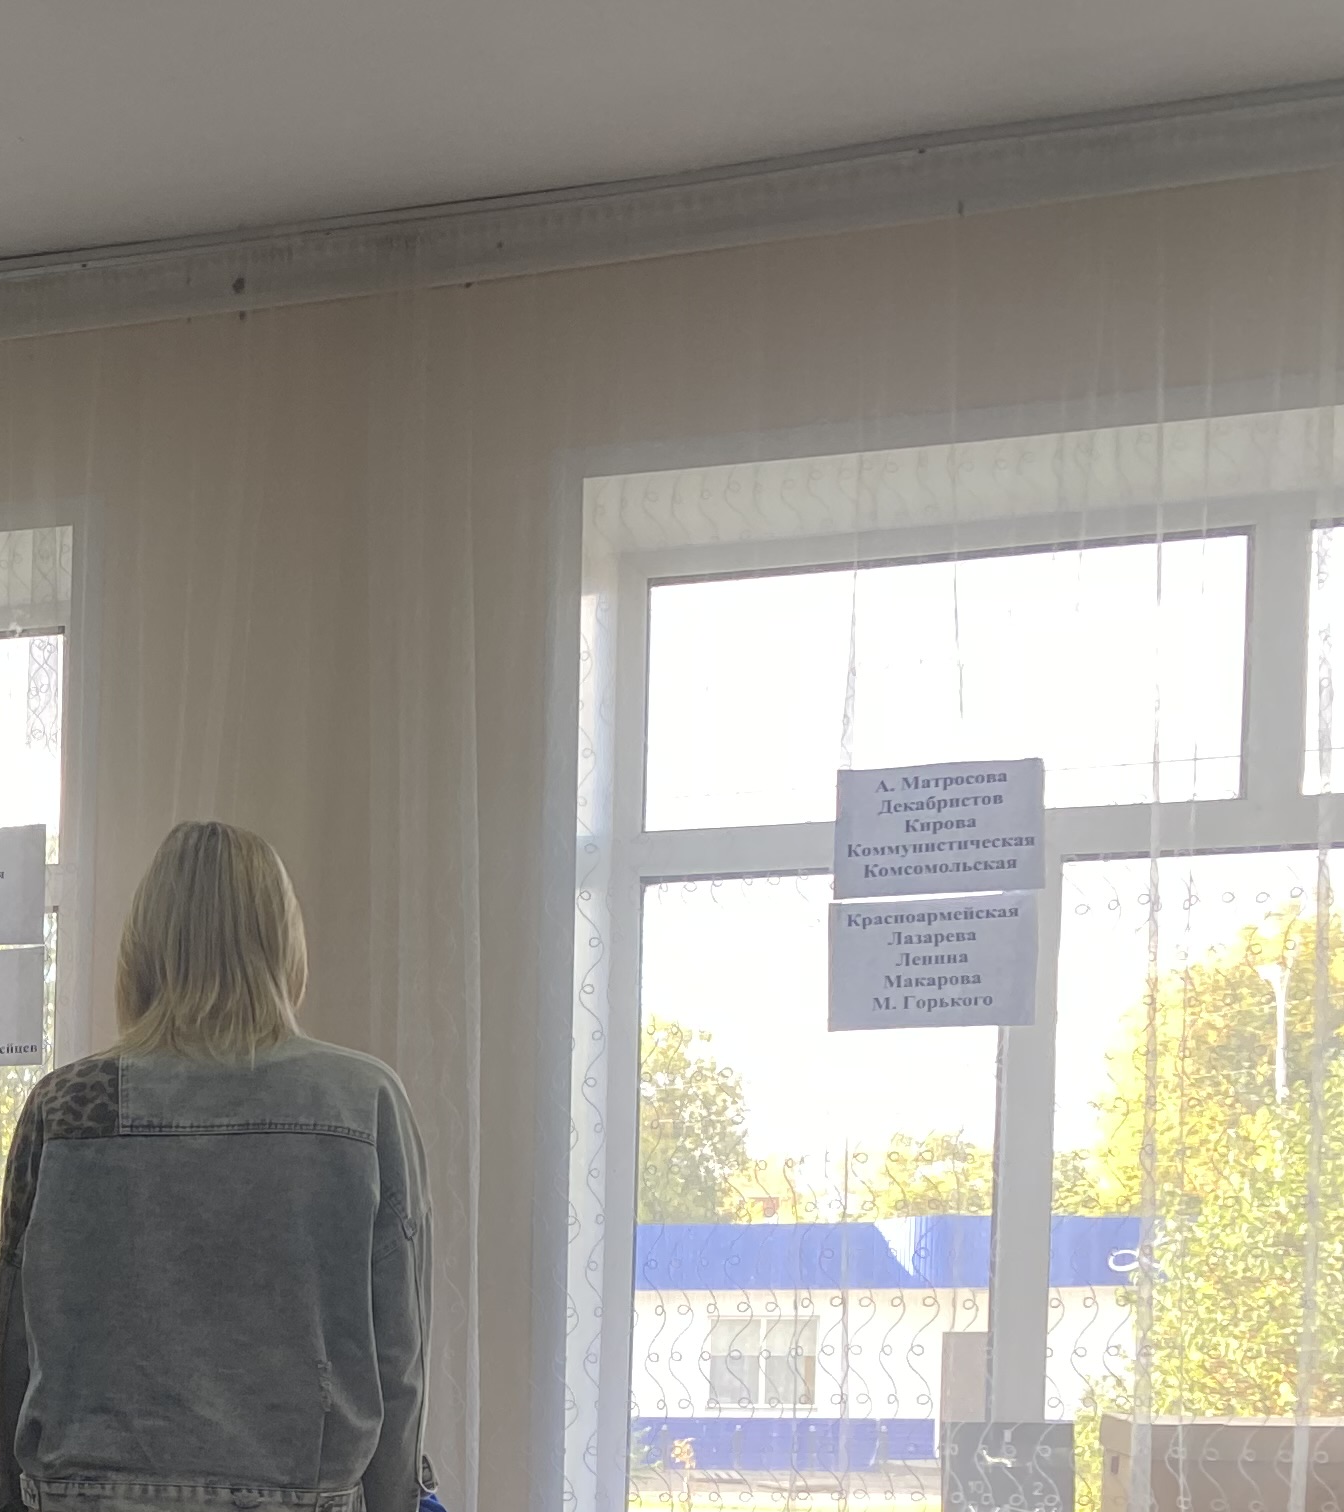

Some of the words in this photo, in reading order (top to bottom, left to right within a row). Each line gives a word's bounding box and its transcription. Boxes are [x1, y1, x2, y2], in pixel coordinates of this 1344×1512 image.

[874, 780, 896, 794] А.
[901, 771, 1007, 791] Матросова
[877, 793, 1004, 816] Декабристов
[904, 817, 977, 835] Кирова
[847, 835, 1035, 859] Коммунистическая
[863, 857, 1018, 879] Комсомольская
[847, 907, 1020, 930] Красноармейская
[887, 930, 977, 947] Лазарева
[895, 952, 969, 967] Ленина
[883, 973, 982, 990] Макарова
[872, 996, 897, 1011] М.
[903, 994, 993, 1013] Горького
